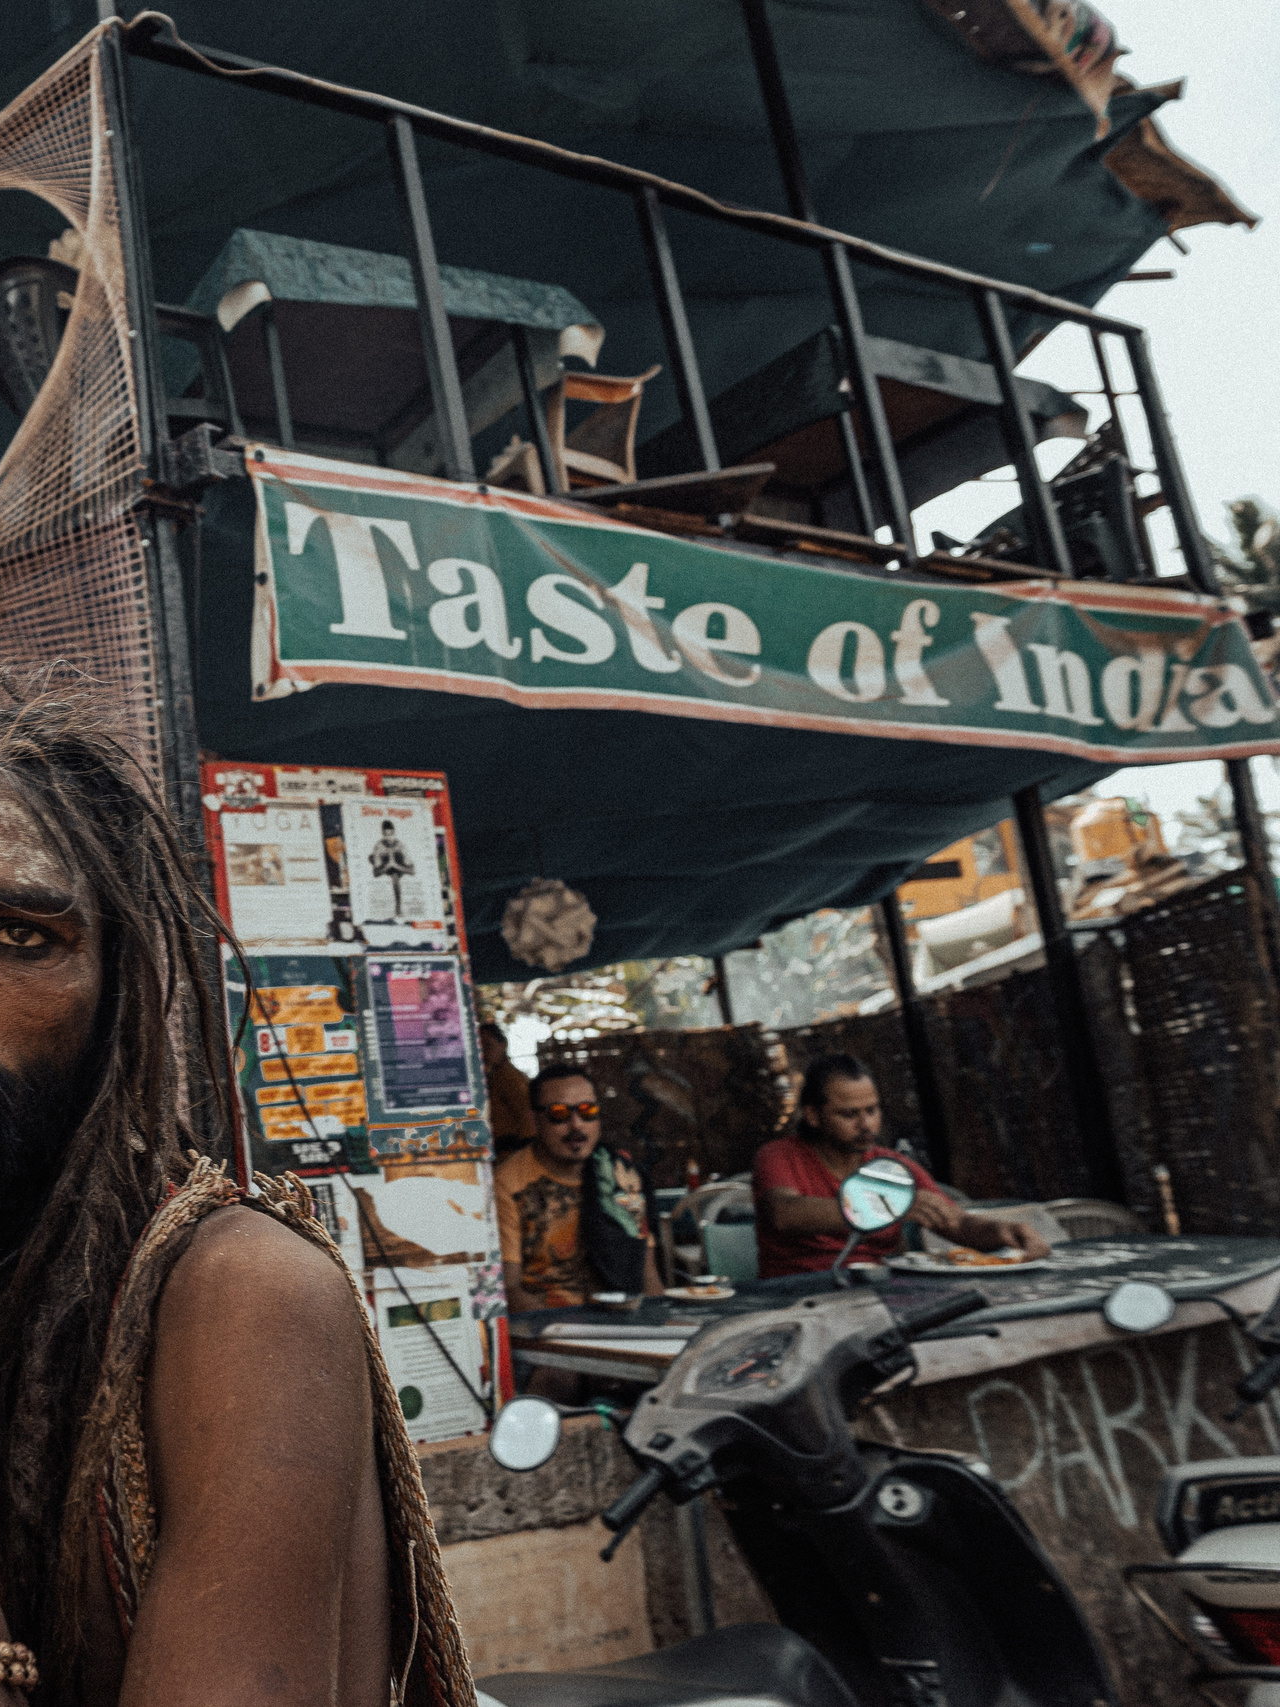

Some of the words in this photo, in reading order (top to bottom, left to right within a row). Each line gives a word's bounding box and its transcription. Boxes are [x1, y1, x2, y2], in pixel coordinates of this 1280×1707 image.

[286, 500, 761, 687] Taste
[806, 599, 949, 708] of
[969, 611, 1277, 732] India
